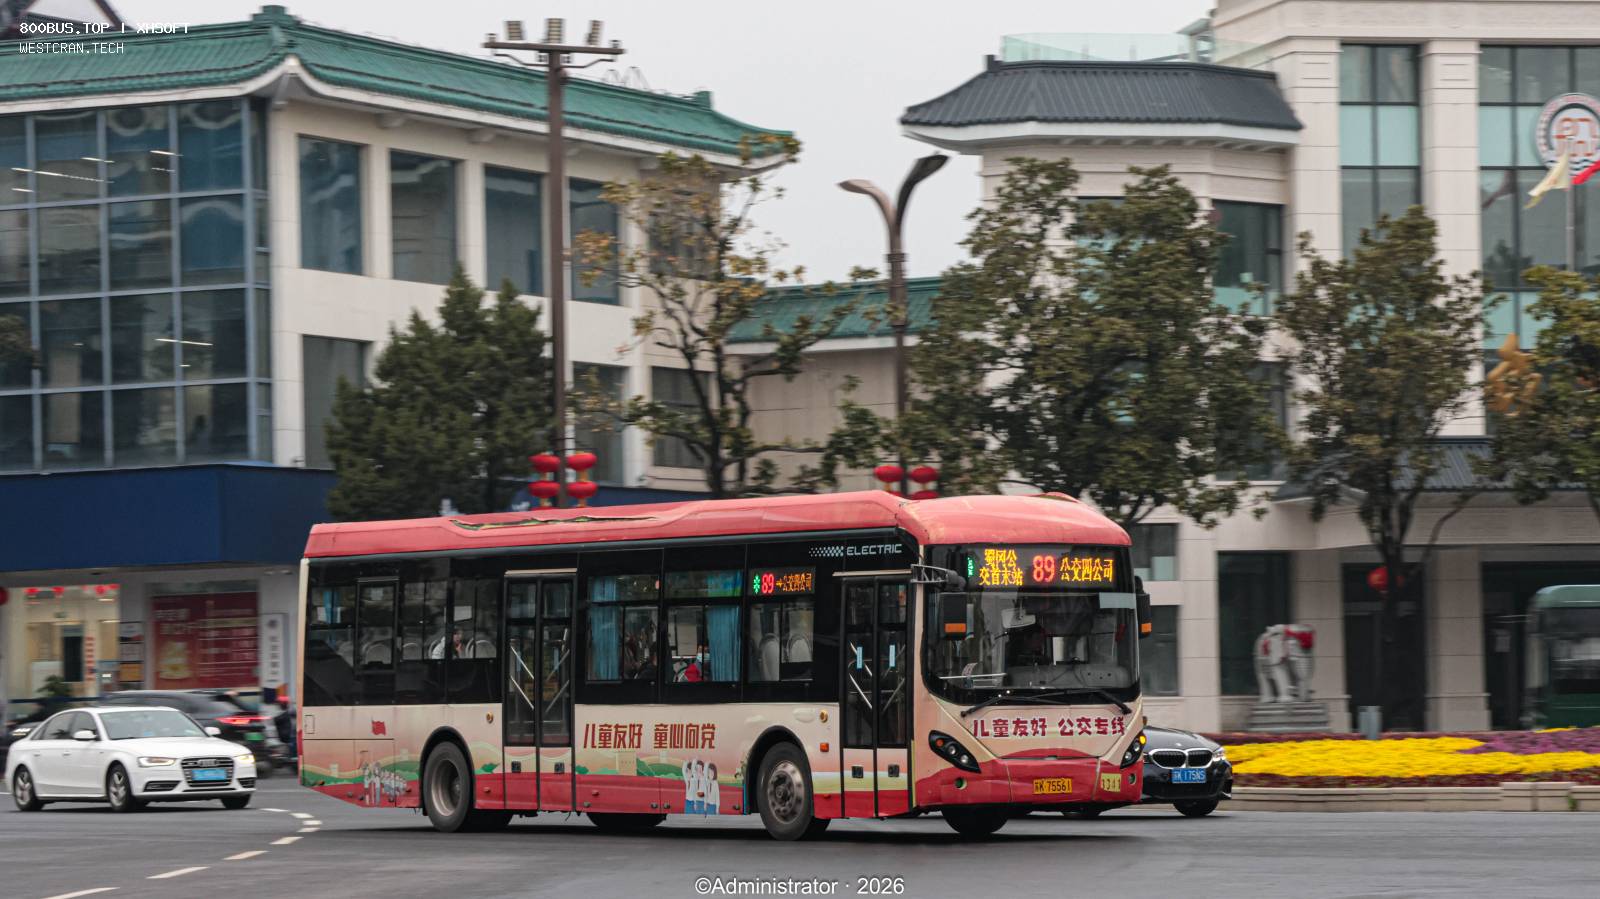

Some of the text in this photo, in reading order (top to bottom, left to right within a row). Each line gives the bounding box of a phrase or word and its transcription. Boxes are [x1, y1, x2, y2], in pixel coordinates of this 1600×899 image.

[846, 543, 903, 556] ELECTRIC
[979, 566, 1023, 586] 交首末站
[1032, 555, 1056, 583] 89
[1060, 557, 1114, 582] 公交四公司
[761, 573, 775, 595] 89
[583, 722, 716, 749] 儿童友好 童心向党
[973, 715, 1126, 738] 儿童友好 公交专线
